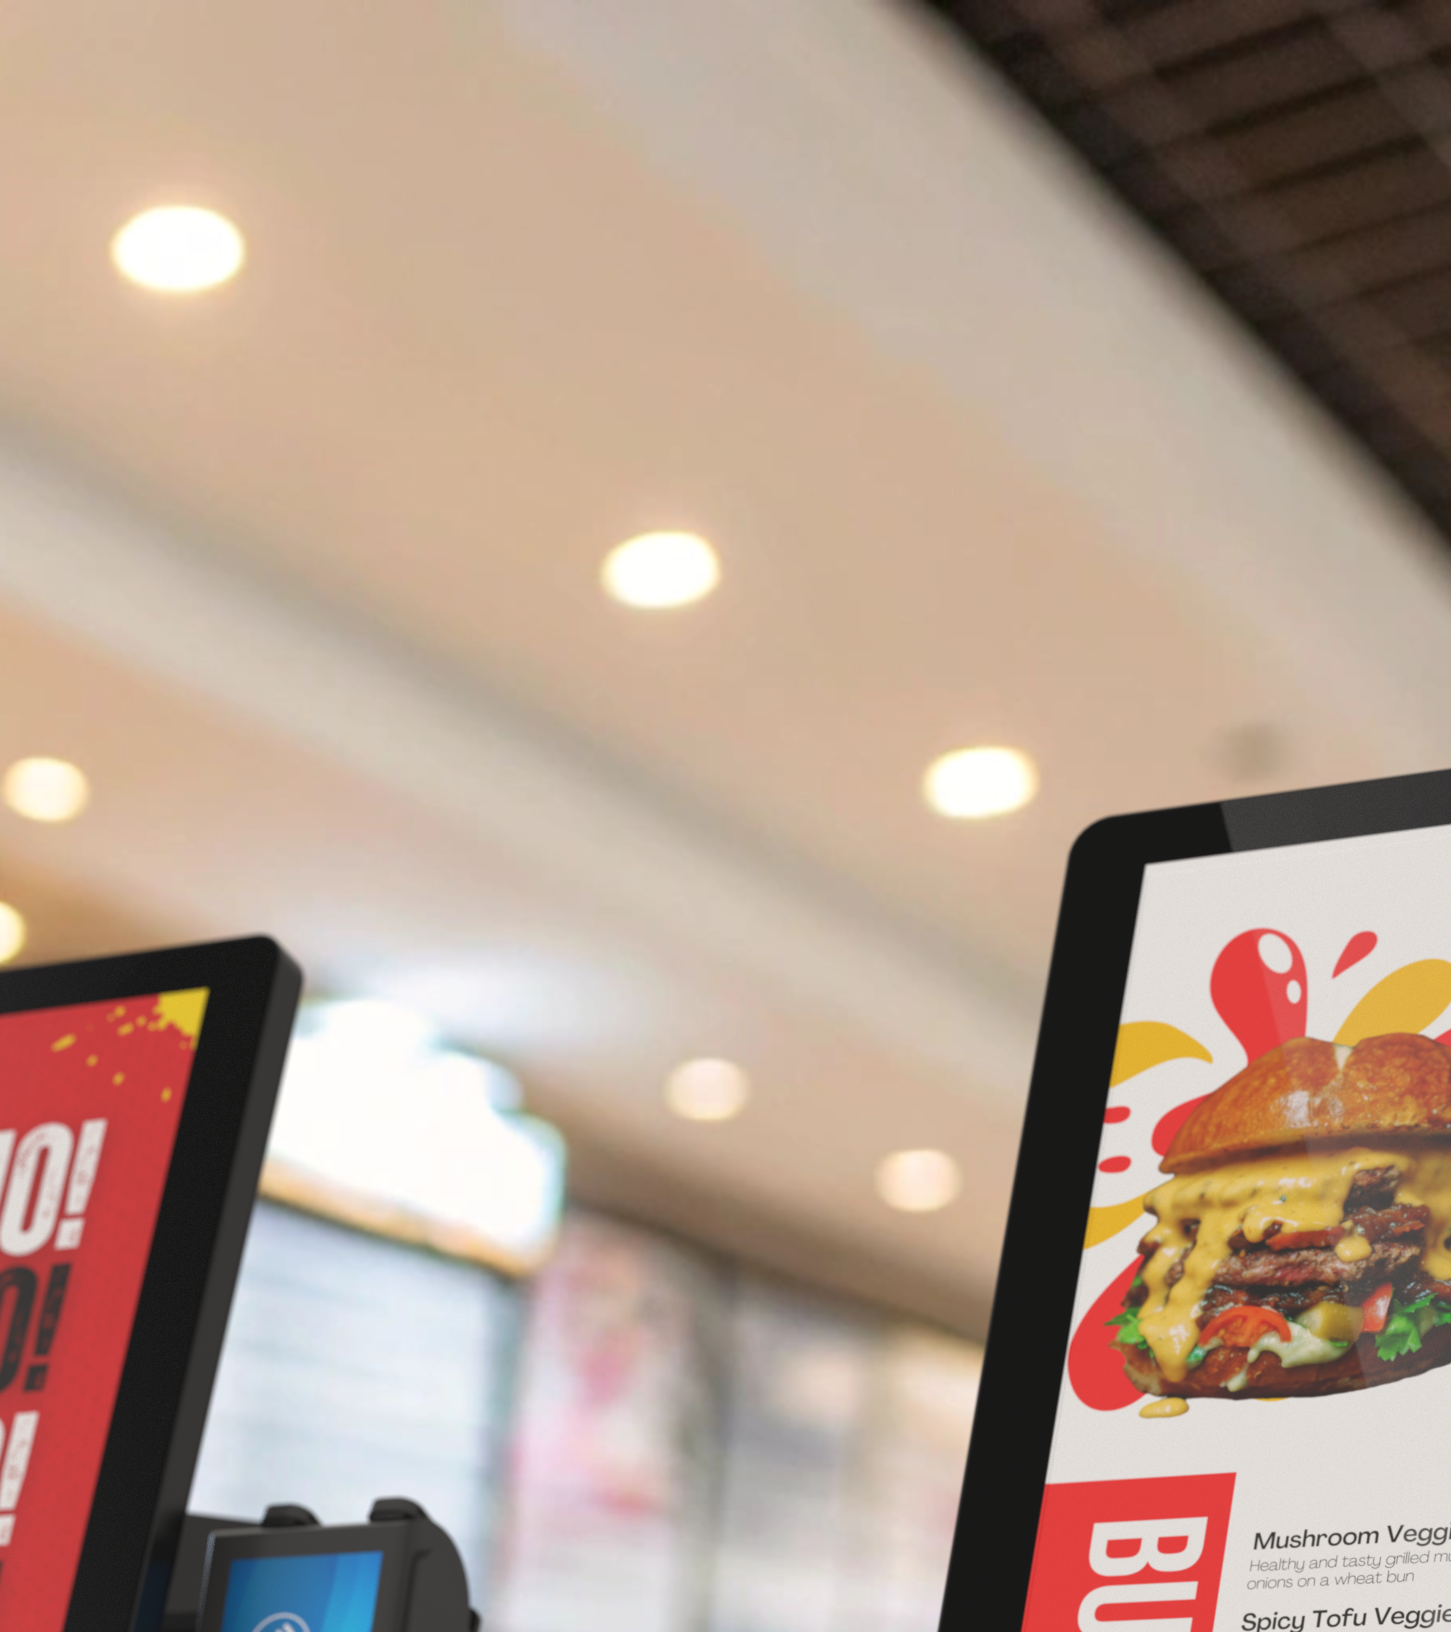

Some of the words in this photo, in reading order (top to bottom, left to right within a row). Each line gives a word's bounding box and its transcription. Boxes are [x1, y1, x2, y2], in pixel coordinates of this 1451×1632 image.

[1253, 1529, 1380, 1551] Mushroom
[1249, 1557, 1306, 1574] Healthy
[1308, 1554, 1339, 1570] and
[1341, 1554, 1382, 1570] tasty
[1384, 1550, 1431, 1569] grilled
[1312, 1607, 1368, 1629] Tofu
